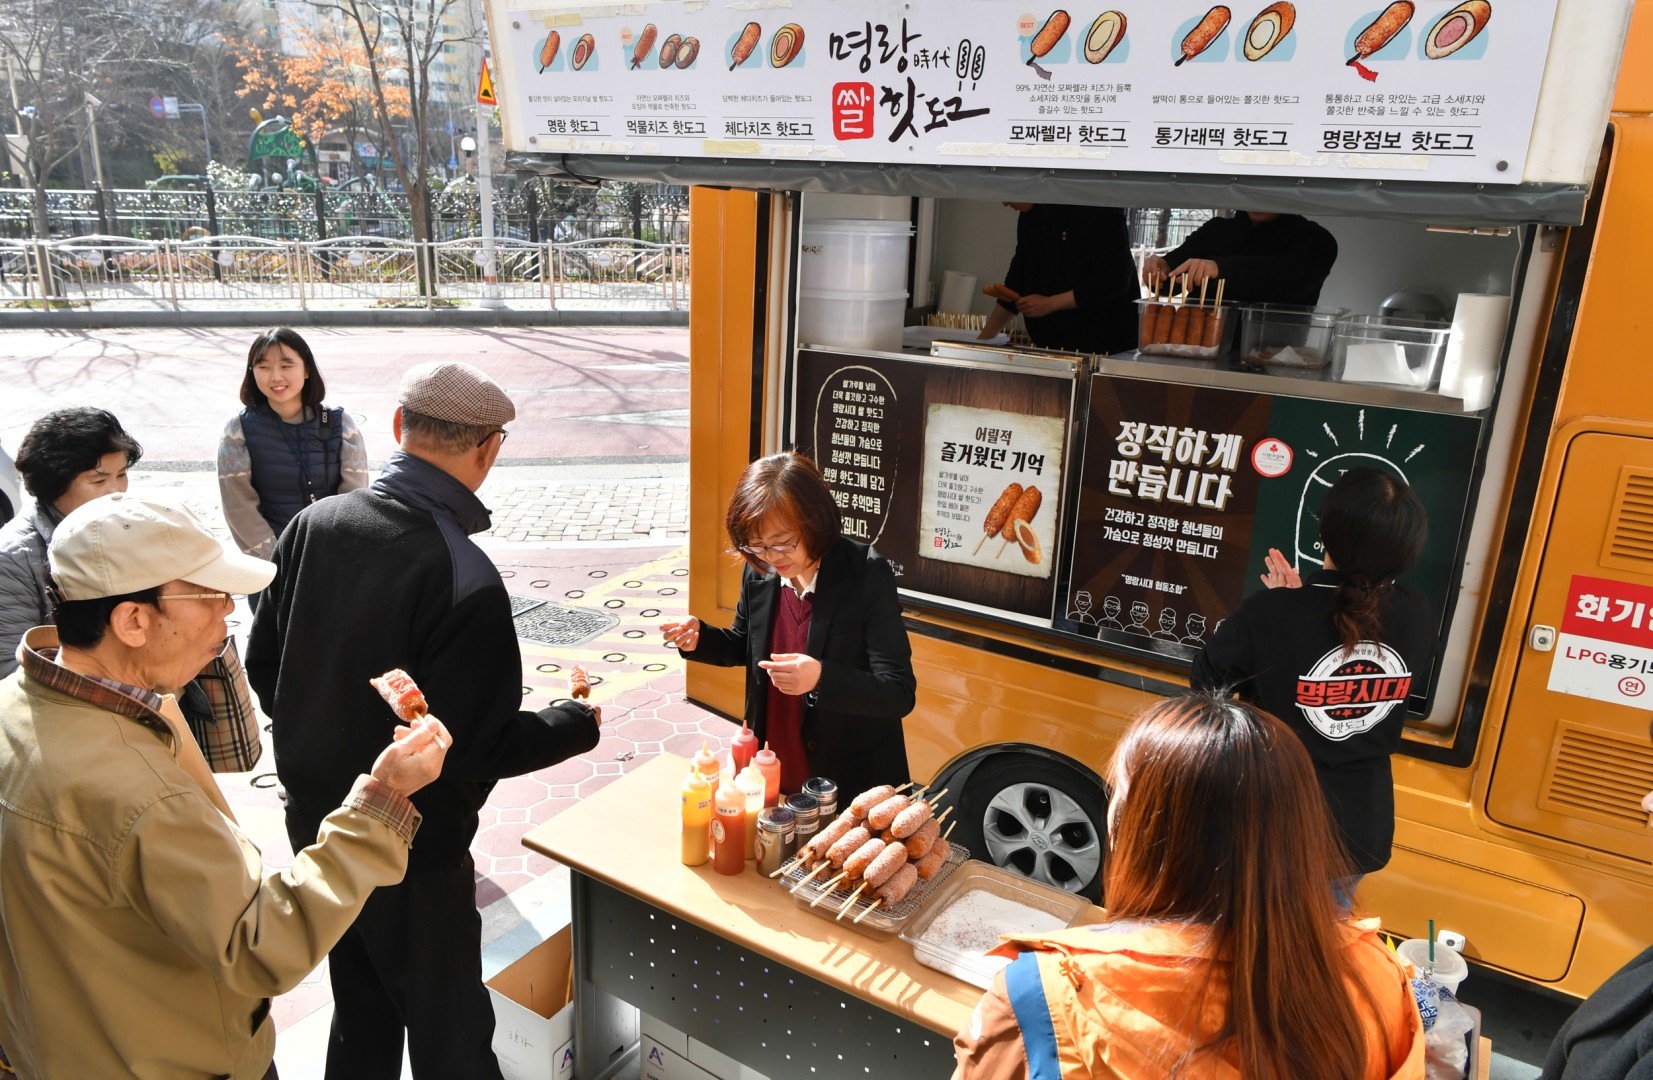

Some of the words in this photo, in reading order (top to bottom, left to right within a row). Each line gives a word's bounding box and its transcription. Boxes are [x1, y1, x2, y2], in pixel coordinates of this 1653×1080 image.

[829, 18, 922, 74] 명랑
[914, 46, 951, 69] 時代
[674, 94, 690, 102] 치즈와
[1015, 84, 1031, 92] 99%
[1033, 84, 1055, 92] 자연산
[1058, 84, 1088, 92] 모짜렐라
[1090, 84, 1114, 92] 치즈가
[681, 103, 697, 111] 핫도그
[794, 95, 812, 103] 핫도그
[1029, 94, 1058, 103] 소세지와
[1061, 94, 1091, 103] 치즈맛을
[1093, 95, 1117, 103] 동시에
[1152, 94, 1176, 104] 쌀떡이
[1179, 94, 1204, 104] 통으로
[1207, 94, 1240, 104] 들어있는
[1243, 94, 1270, 104] 쫄깃한
[1273, 95, 1300, 105] 핫도그
[1325, 93, 1362, 104] 통통하고
[1365, 94, 1385, 104] 더욱
[1388, 94, 1418, 104] 맛있는
[1421, 94, 1441, 104] 고급
[1444, 94, 1486, 105] 소세지와
[837, 87, 870, 133] 쌀
[879, 76, 990, 142] 핫도그
[1038, 105, 1060, 114] 즐길수
[1063, 106, 1078, 115] 있는
[1080, 106, 1103, 115] 핫도그
[1326, 105, 1354, 116] 쫄깃한
[1357, 105, 1386, 116] 반죽을
[1388, 106, 1409, 116] 느낄
[1412, 106, 1422, 117] 수
[1426, 106, 1446, 117] 있는
[1450, 106, 1480, 117] 핫도그
[547, 119, 567, 133] 명랑
[570, 119, 600, 133] 핫도그
[627, 120, 669, 135] 먹물치즈
[672, 120, 706, 135] 핫도그
[725, 121, 772, 136] 체다치즈
[776, 121, 813, 137] 핫도그
[1009, 125, 1072, 143] 모짜렐라
[1078, 125, 1127, 143] 핫도그
[1155, 126, 1225, 147] 통가래떡
[1233, 127, 1288, 147] 핫도그
[1323, 130, 1401, 150] 명랑점보
[1411, 131, 1474, 151] 핫도그
[842, 379, 864, 391] 쌀가루를
[832, 390, 844, 400] 더욱
[844, 391, 866, 403] 쫄깃하고
[868, 394, 885, 405] 구수한
[832, 403, 856, 416] 명랑시대
[857, 406, 865, 417] 쌀
[866, 407, 884, 419] 핫도그
[834, 417, 860, 431] 건강하고
[861, 420, 880, 434] 정직한
[831, 432, 856, 447] 청년들의
[858, 436, 883, 452] 가슴으로
[975, 426, 1013, 446] 어릴적
[1115, 420, 1244, 471] 정직하게
[831, 449, 852, 465] 정성껏
[853, 453, 881, 470] 만듭니다
[941, 441, 1007, 470] 즐거웠던
[1010, 451, 1045, 476] 기억
[839, 470, 868, 489] 핫도그에
[870, 474, 885, 491] 담긴
[1108, 459, 1233, 511] 만듭니다
[851, 493, 881, 515] 추억만큼
[840, 515, 871, 539] 집니다.
[1104, 507, 1145, 527] 건강하고
[1147, 514, 1179, 532] 정직한
[1181, 520, 1223, 540] 청년들의
[1103, 526, 1140, 545] 가슴으로
[1142, 533, 1174, 551] 정성껏
[1175, 538, 1219, 559] 만듭니다
[1575, 593, 1653, 632] 화기
[1296, 677, 1412, 706] 명랑시대
[1625, 680, 1639, 692] 연
